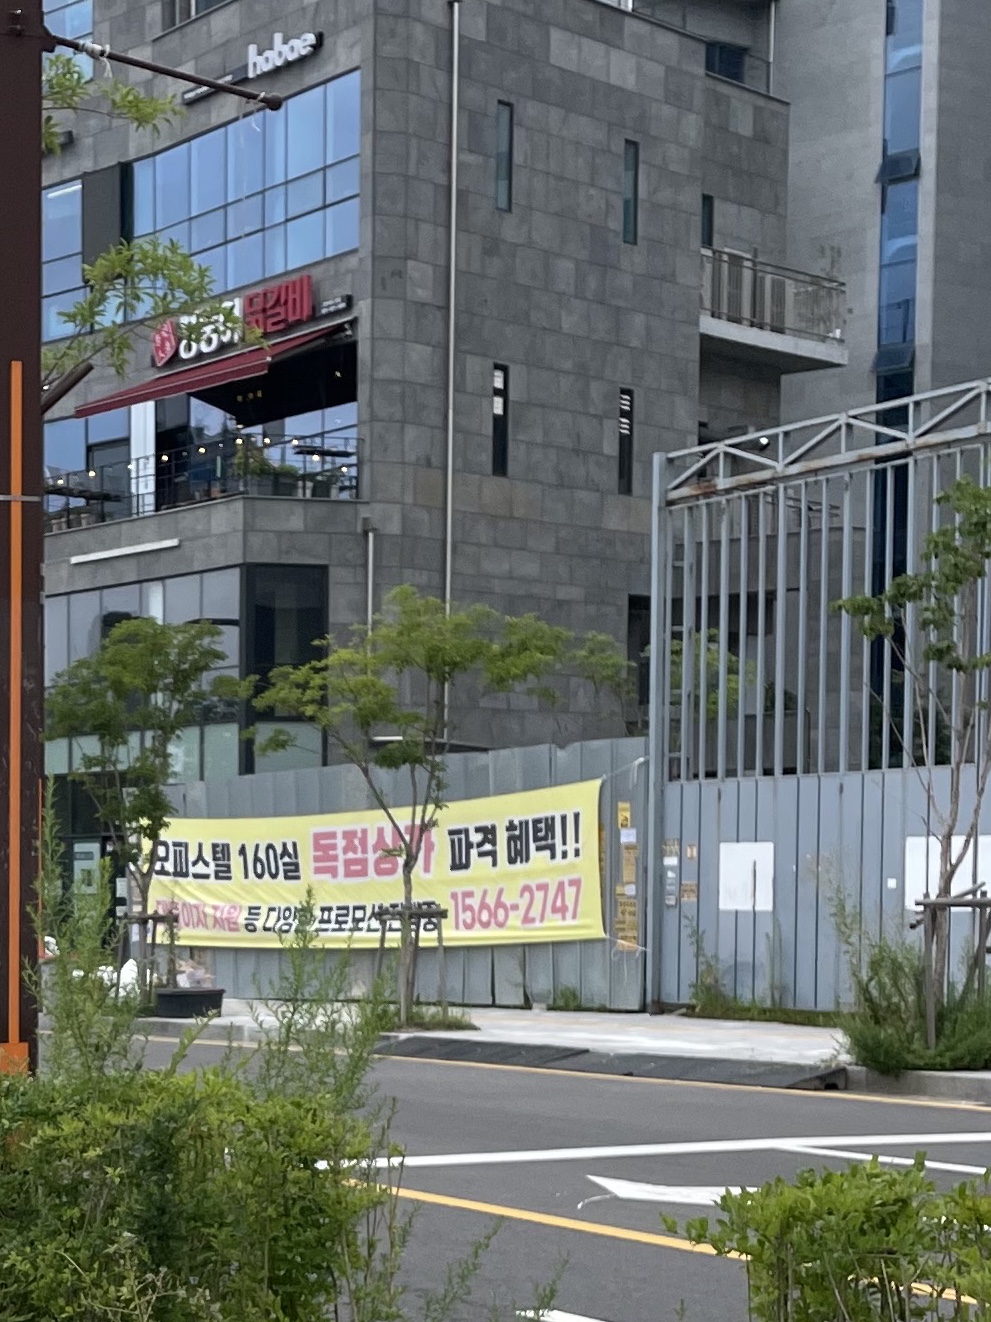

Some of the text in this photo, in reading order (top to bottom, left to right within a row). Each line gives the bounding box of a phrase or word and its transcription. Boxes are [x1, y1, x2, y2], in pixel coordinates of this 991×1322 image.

[155, 840, 233, 881] 오피스텔
[238, 841, 301, 880] 160실
[313, 824, 434, 879] 독점상가
[446, 823, 497, 871] 파격
[211, 904, 241, 933] 지원
[244, 905, 261, 933] 등
[449, 877, 582, 931] 1566-2747
